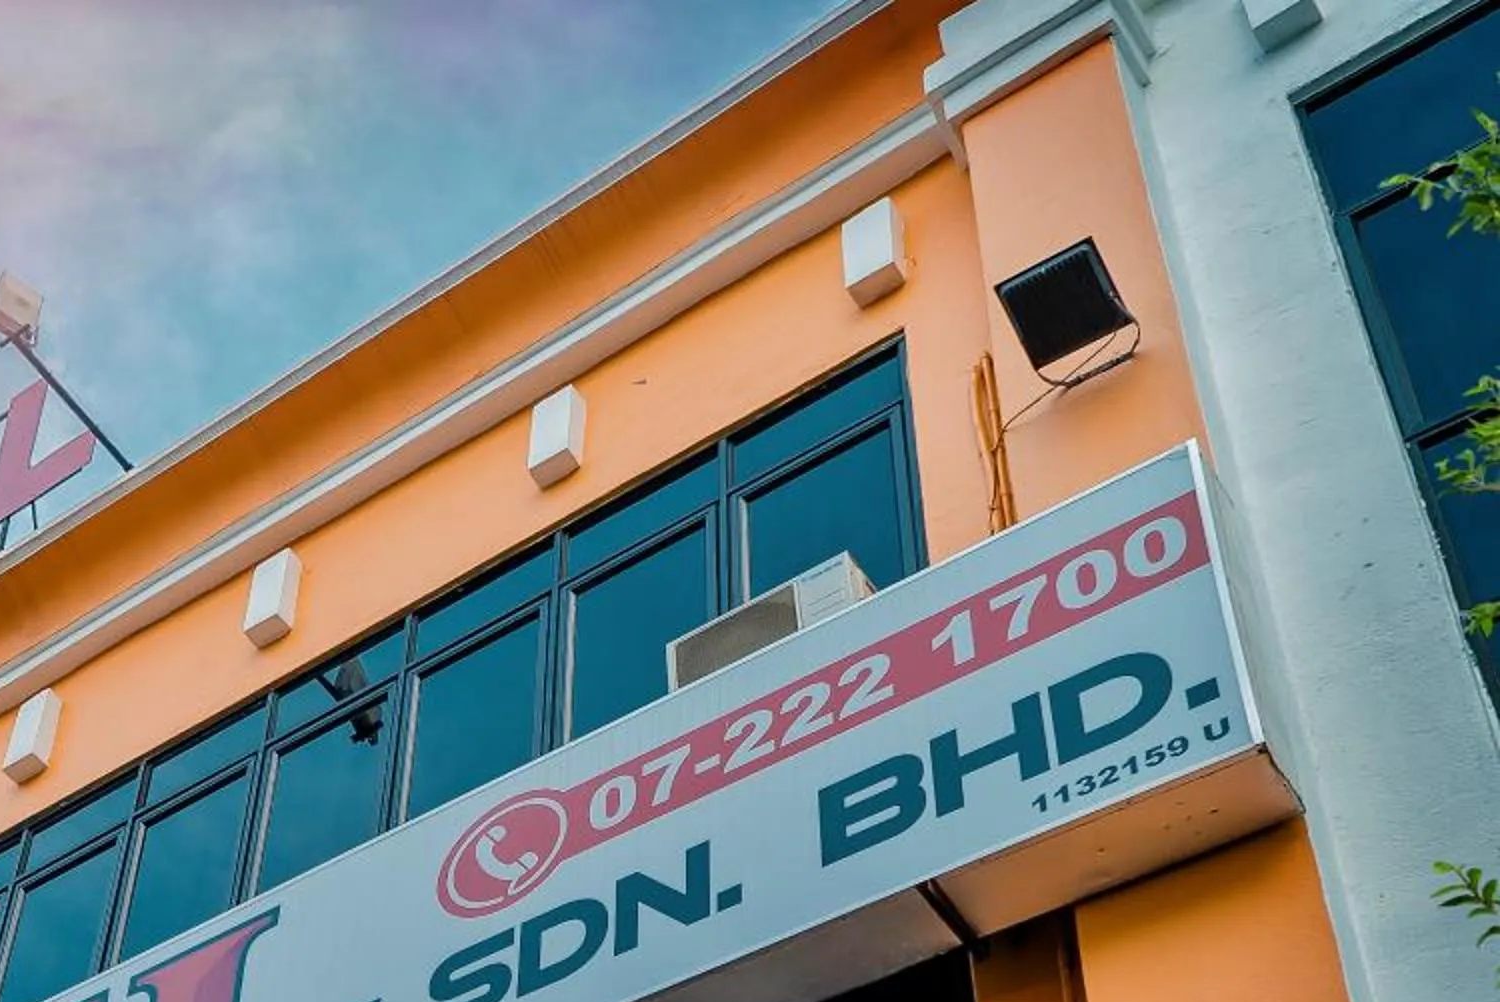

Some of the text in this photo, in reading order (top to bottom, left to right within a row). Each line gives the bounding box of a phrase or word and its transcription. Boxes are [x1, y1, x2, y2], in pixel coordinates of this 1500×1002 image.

[589, 516, 1188, 830] 07-222 1700
[819, 651, 1223, 866] BHD.
[1031, 716, 1231, 813] 1132159 U
